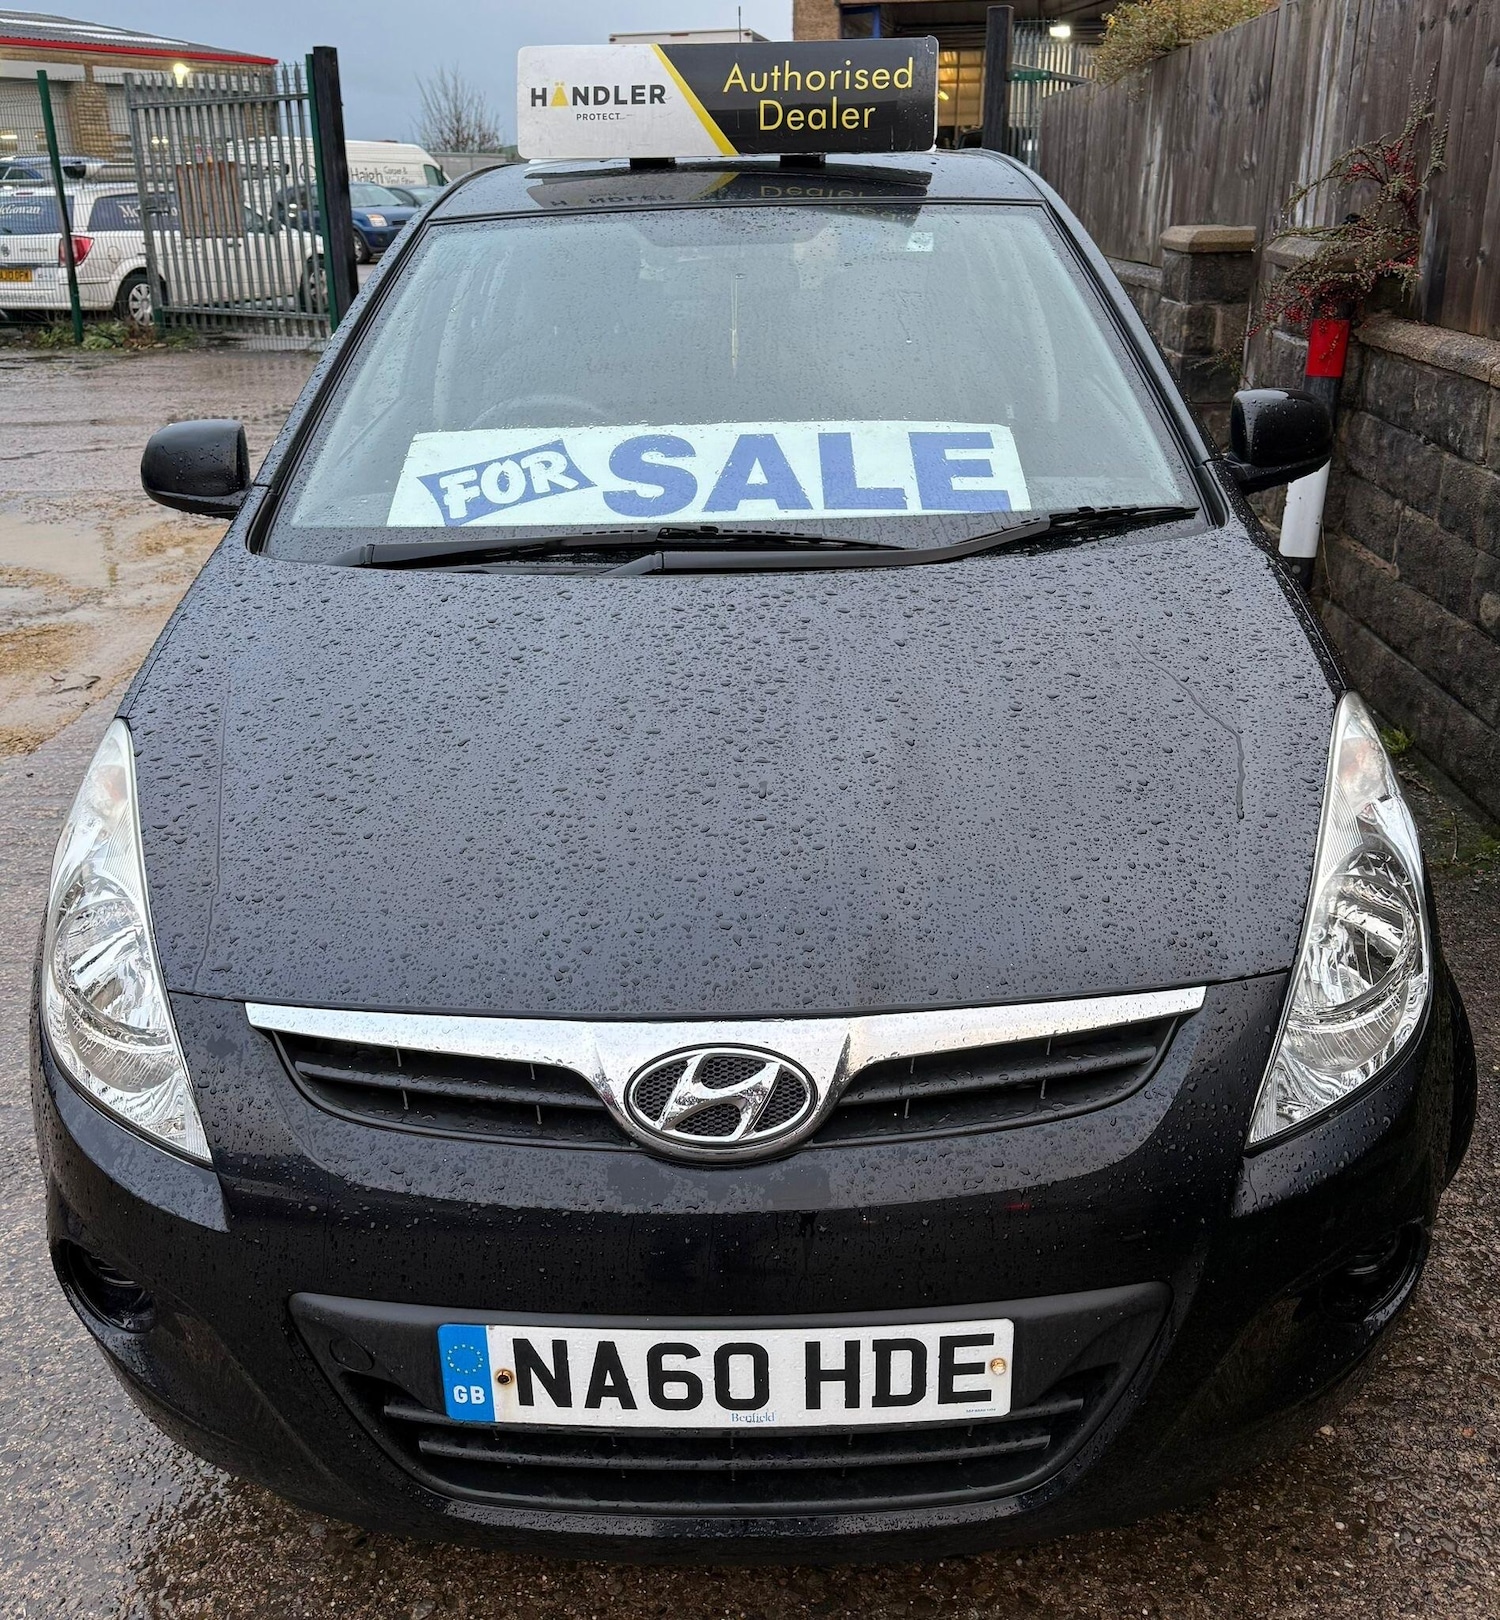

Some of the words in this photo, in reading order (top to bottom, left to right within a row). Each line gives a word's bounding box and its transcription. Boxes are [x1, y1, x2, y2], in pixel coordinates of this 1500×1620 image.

[723, 57, 914, 93] Authorised
[531, 81, 666, 107] HÄNDLER
[576, 112, 621, 121] PROTECT
[759, 96, 876, 131] Dealer
[440, 450, 581, 519] FOR
[604, 431, 1012, 518] SALE
[512, 1338, 769, 1411] NA60
[804, 1333, 995, 1410] HDE
[453, 1386, 486, 1404] GB
[731, 1411, 775, 1423] Benfield
